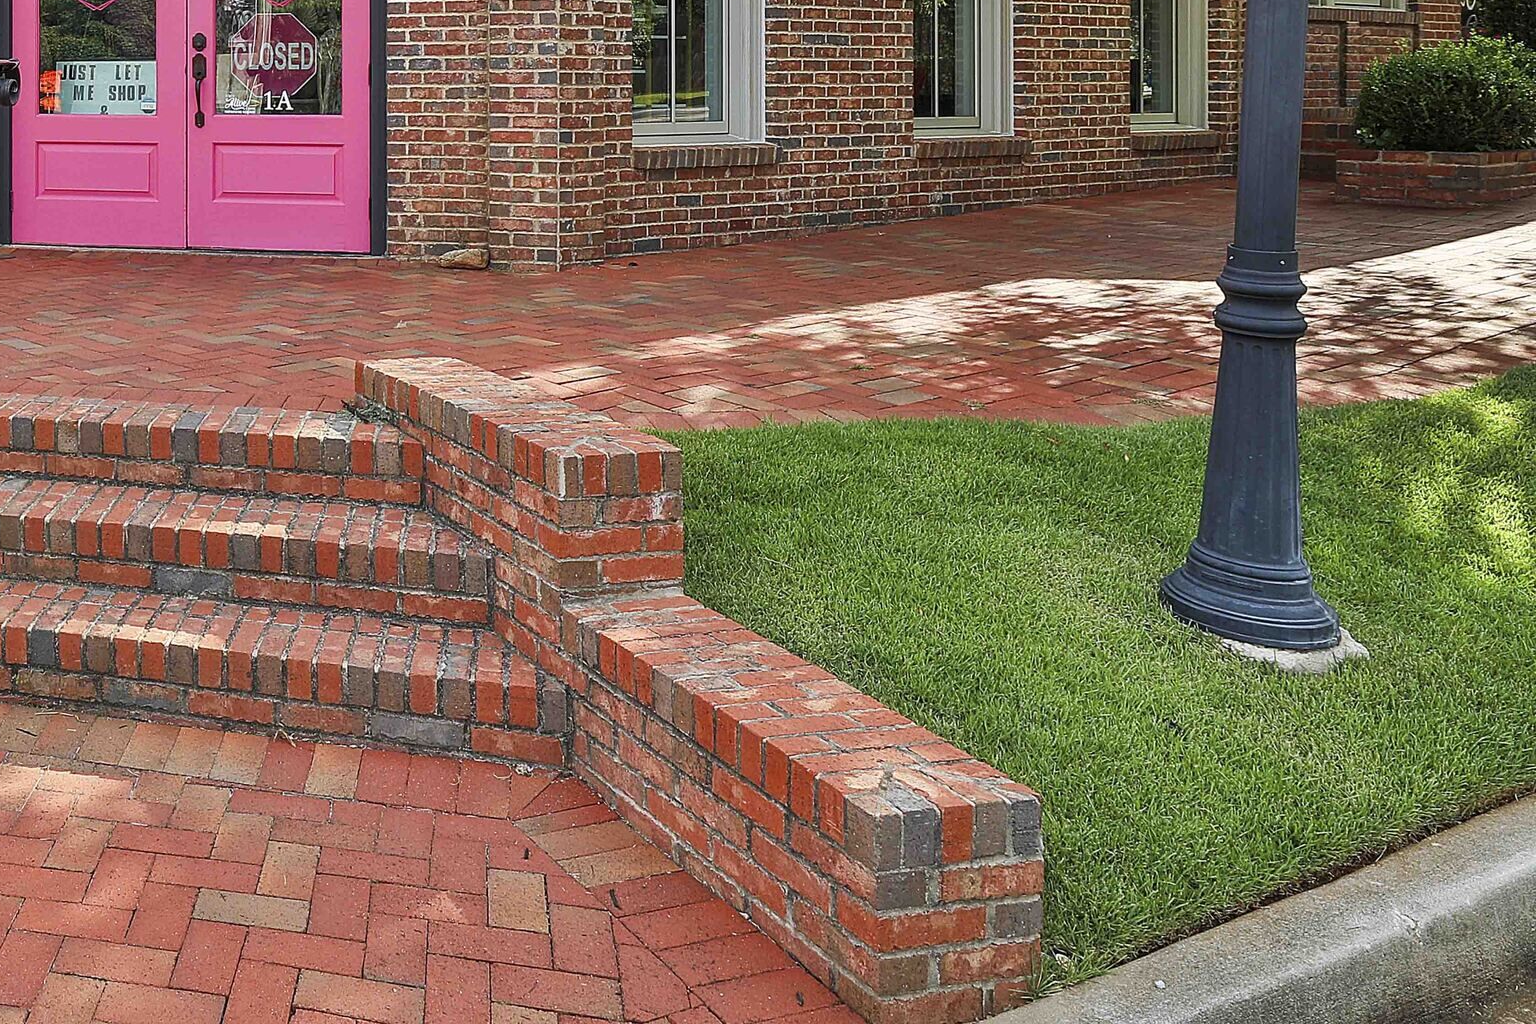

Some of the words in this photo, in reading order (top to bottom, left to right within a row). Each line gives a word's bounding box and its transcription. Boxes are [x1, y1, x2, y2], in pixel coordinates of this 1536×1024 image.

[233, 42, 314, 70] CLOSED
[60, 64, 96, 81] JUST
[115, 64, 141, 81] LET
[73, 85, 94, 101] ME
[108, 85, 146, 101] SHOP
